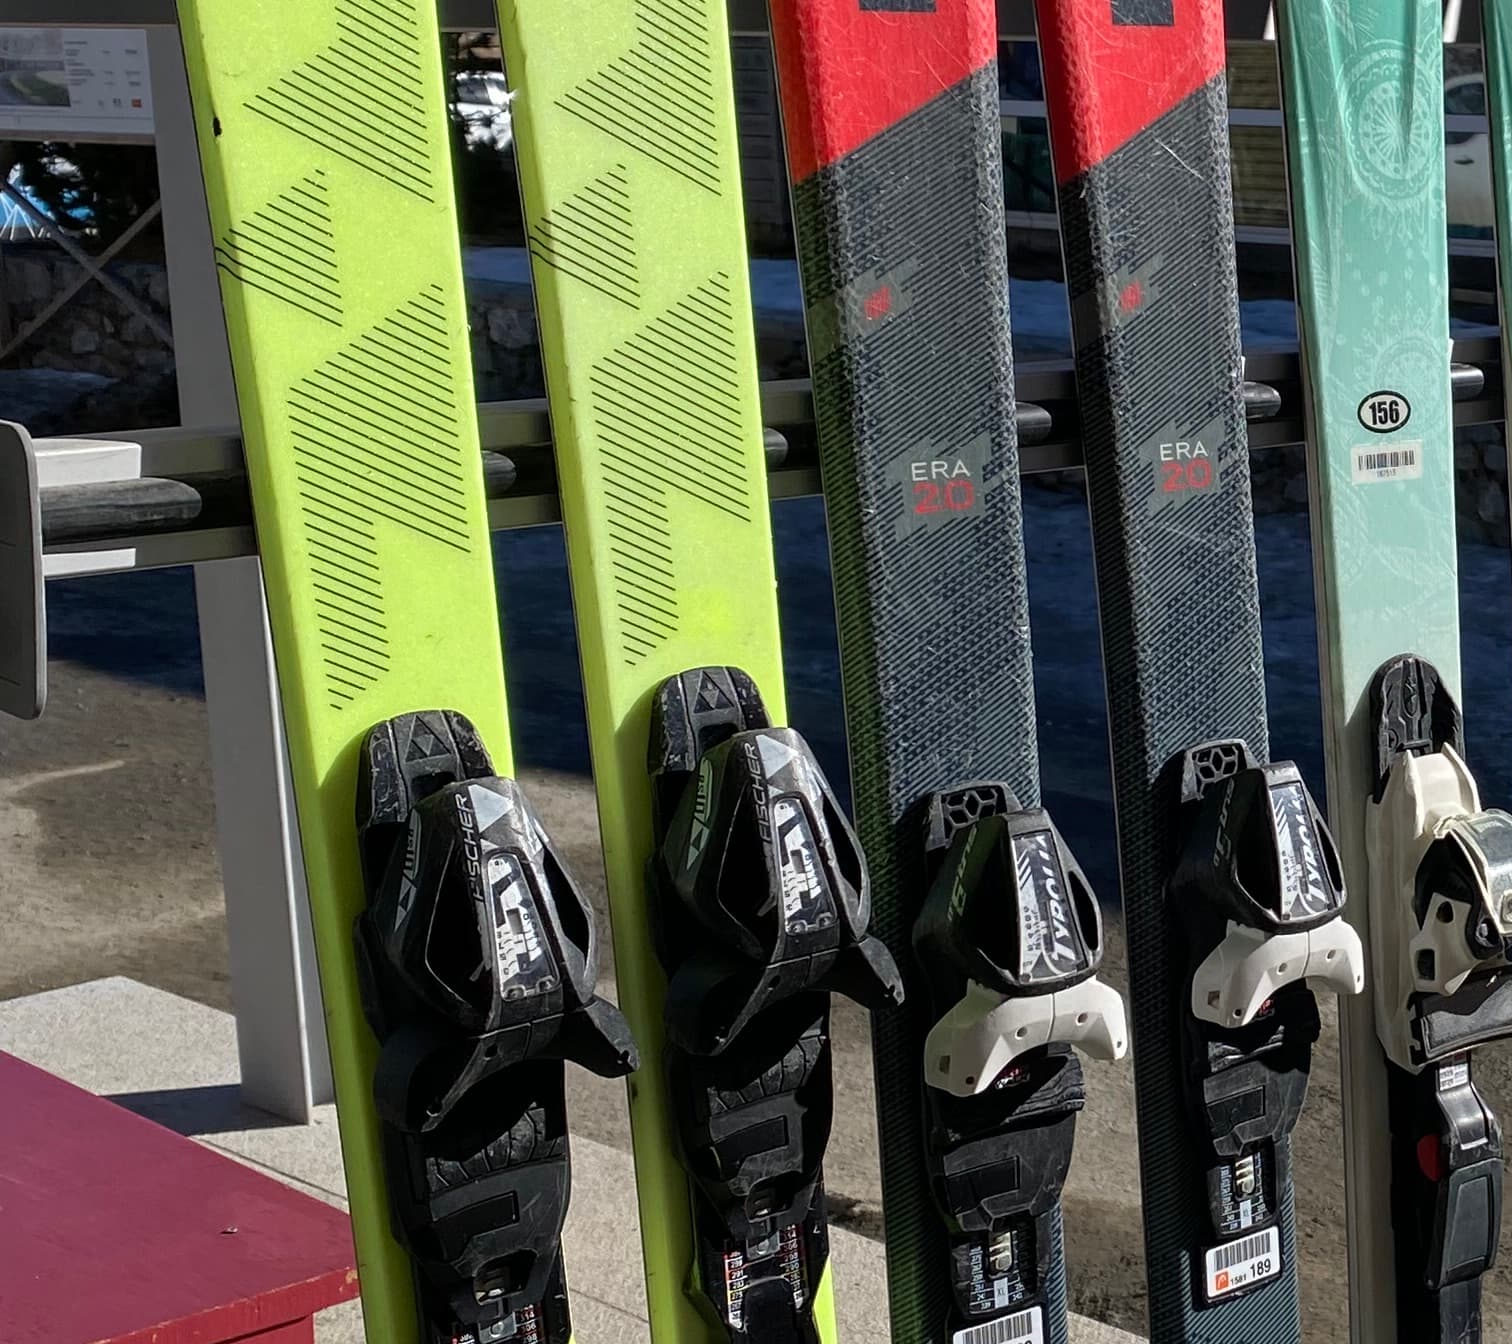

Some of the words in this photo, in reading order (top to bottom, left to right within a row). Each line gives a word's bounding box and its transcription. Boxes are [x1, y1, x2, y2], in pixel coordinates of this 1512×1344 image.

[1369, 401, 1401, 425] 156
[1159, 442, 1208, 461] ERA
[911, 461, 970, 482] ERA
[744, 742, 773, 844] FISCHER
[455, 793, 485, 905] FISCHER
[1250, 1258, 1271, 1278] 189
